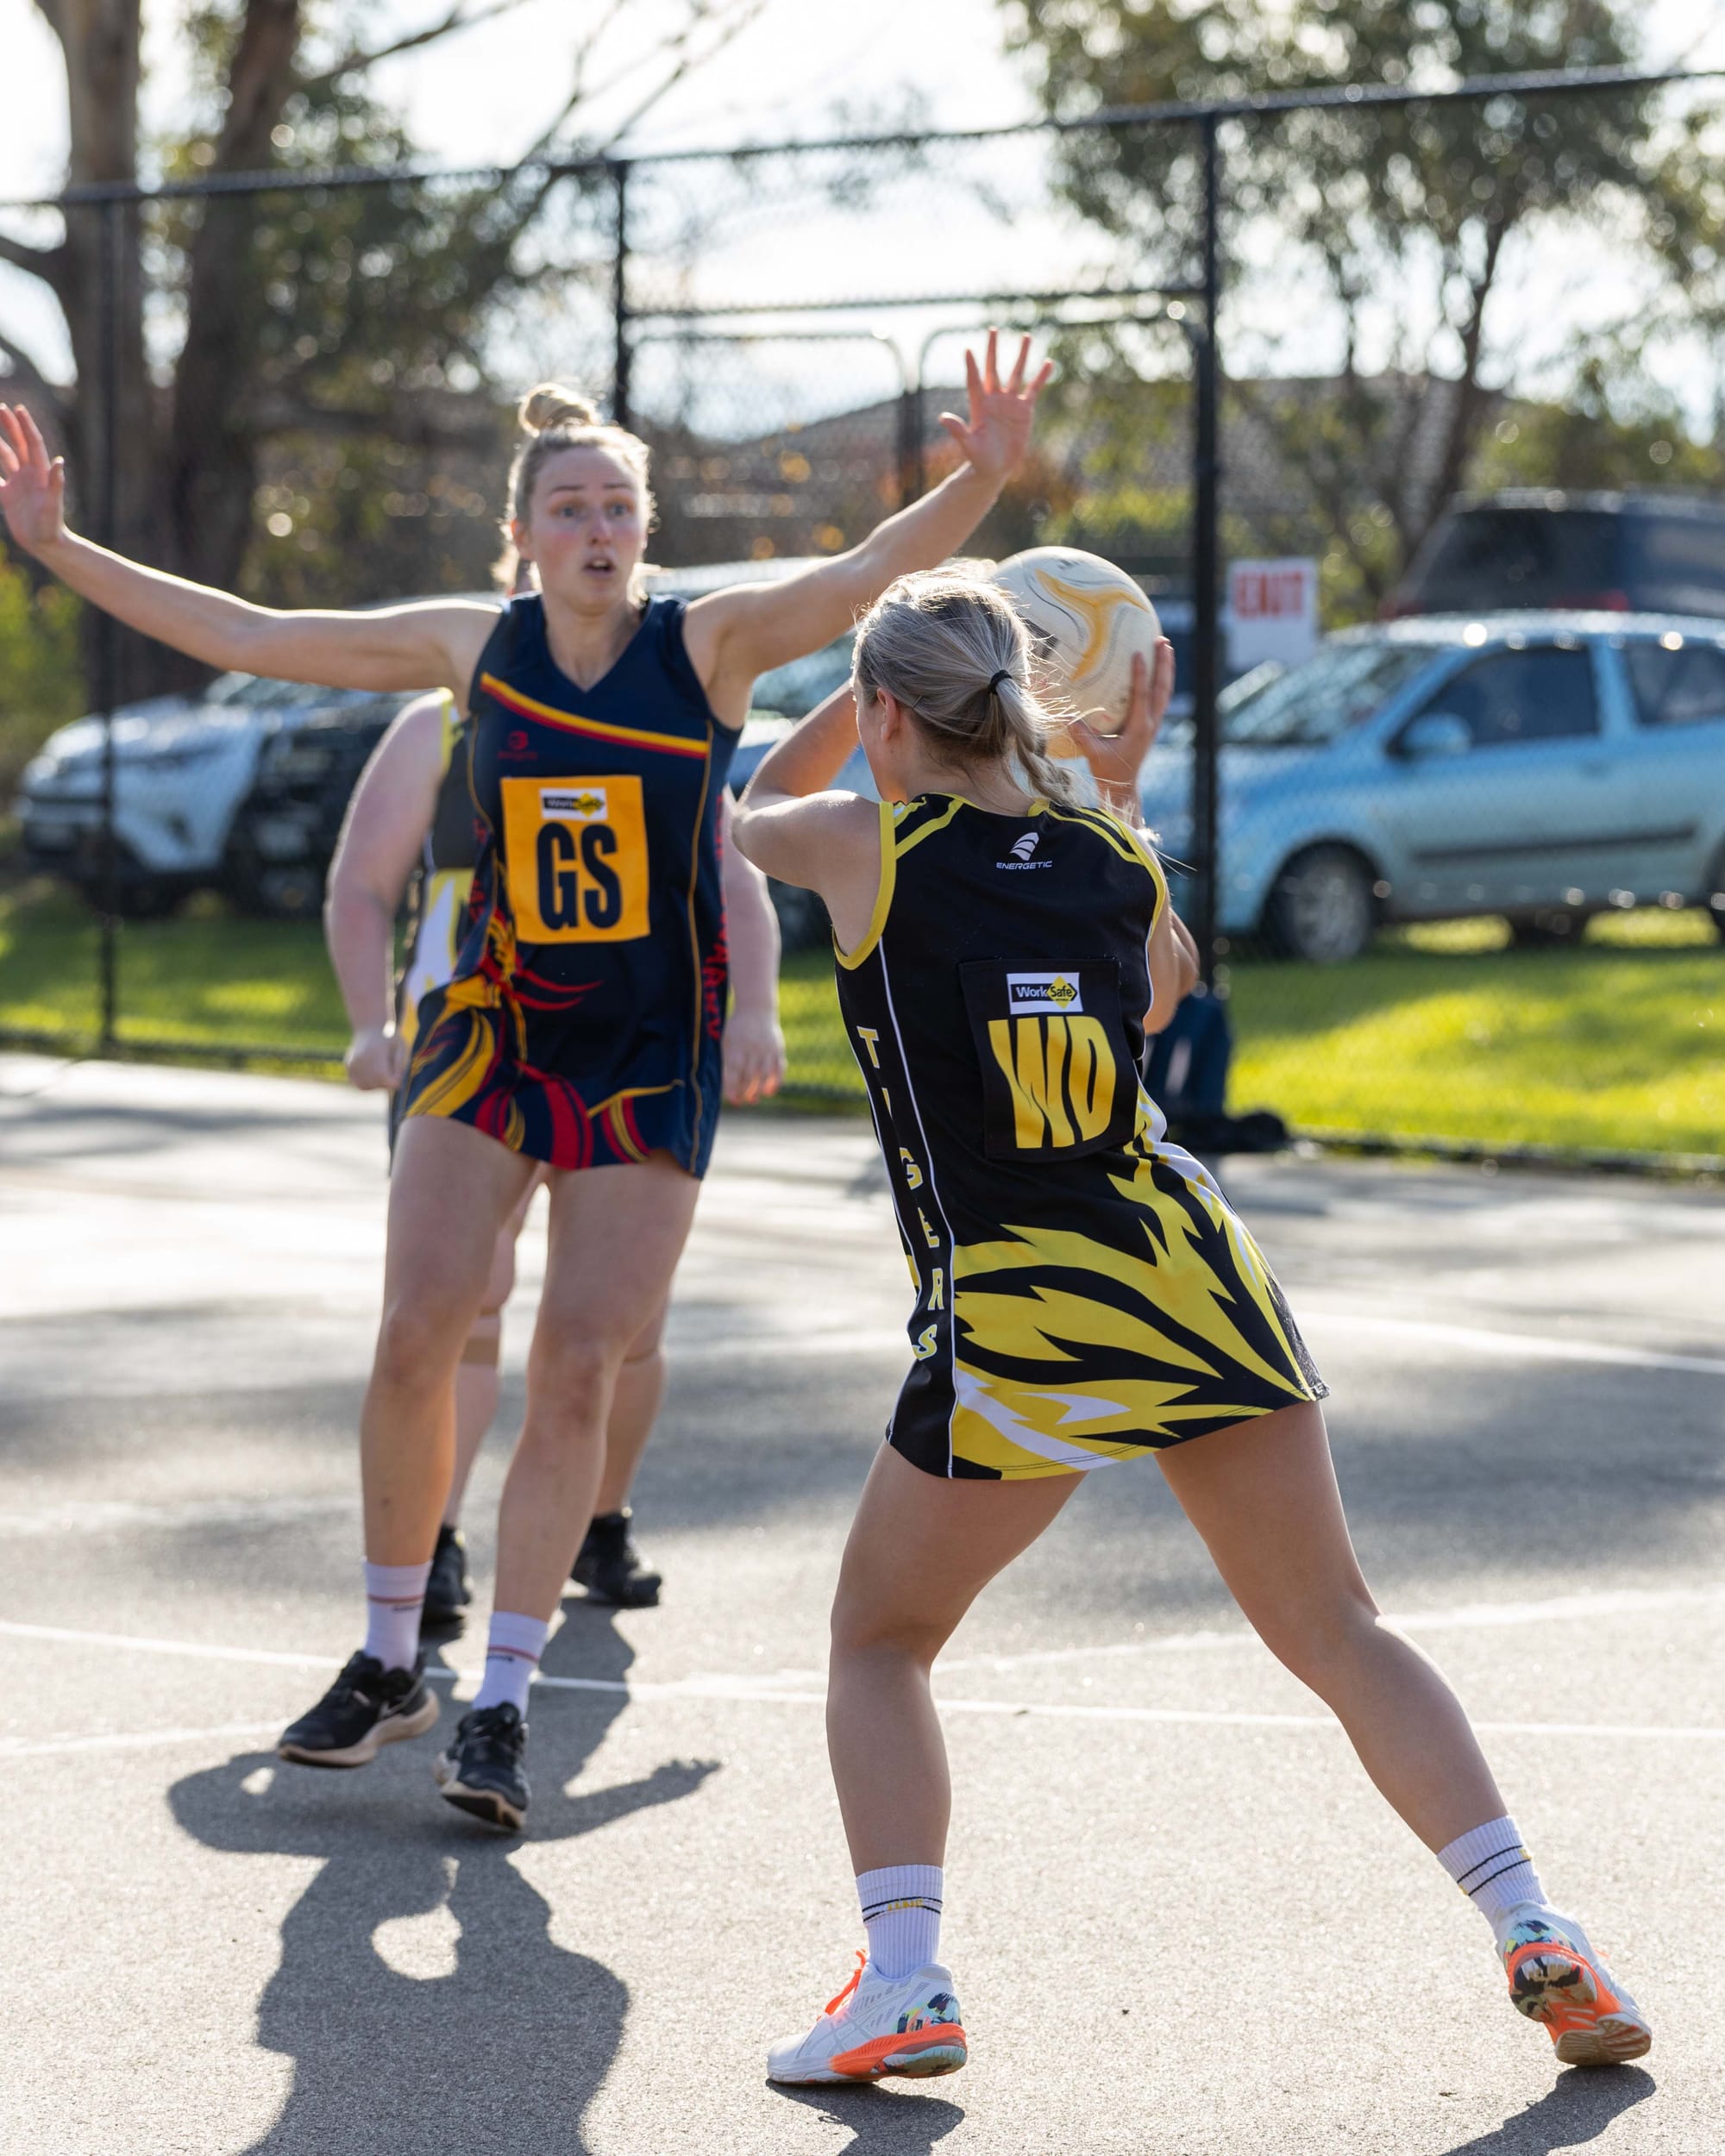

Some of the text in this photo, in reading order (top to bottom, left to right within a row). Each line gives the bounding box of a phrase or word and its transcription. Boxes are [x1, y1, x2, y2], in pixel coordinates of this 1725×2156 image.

[536, 821, 621, 930] GS
[995, 861, 1053, 870] ENERGETIC
[988, 1016, 1116, 1149] WD
